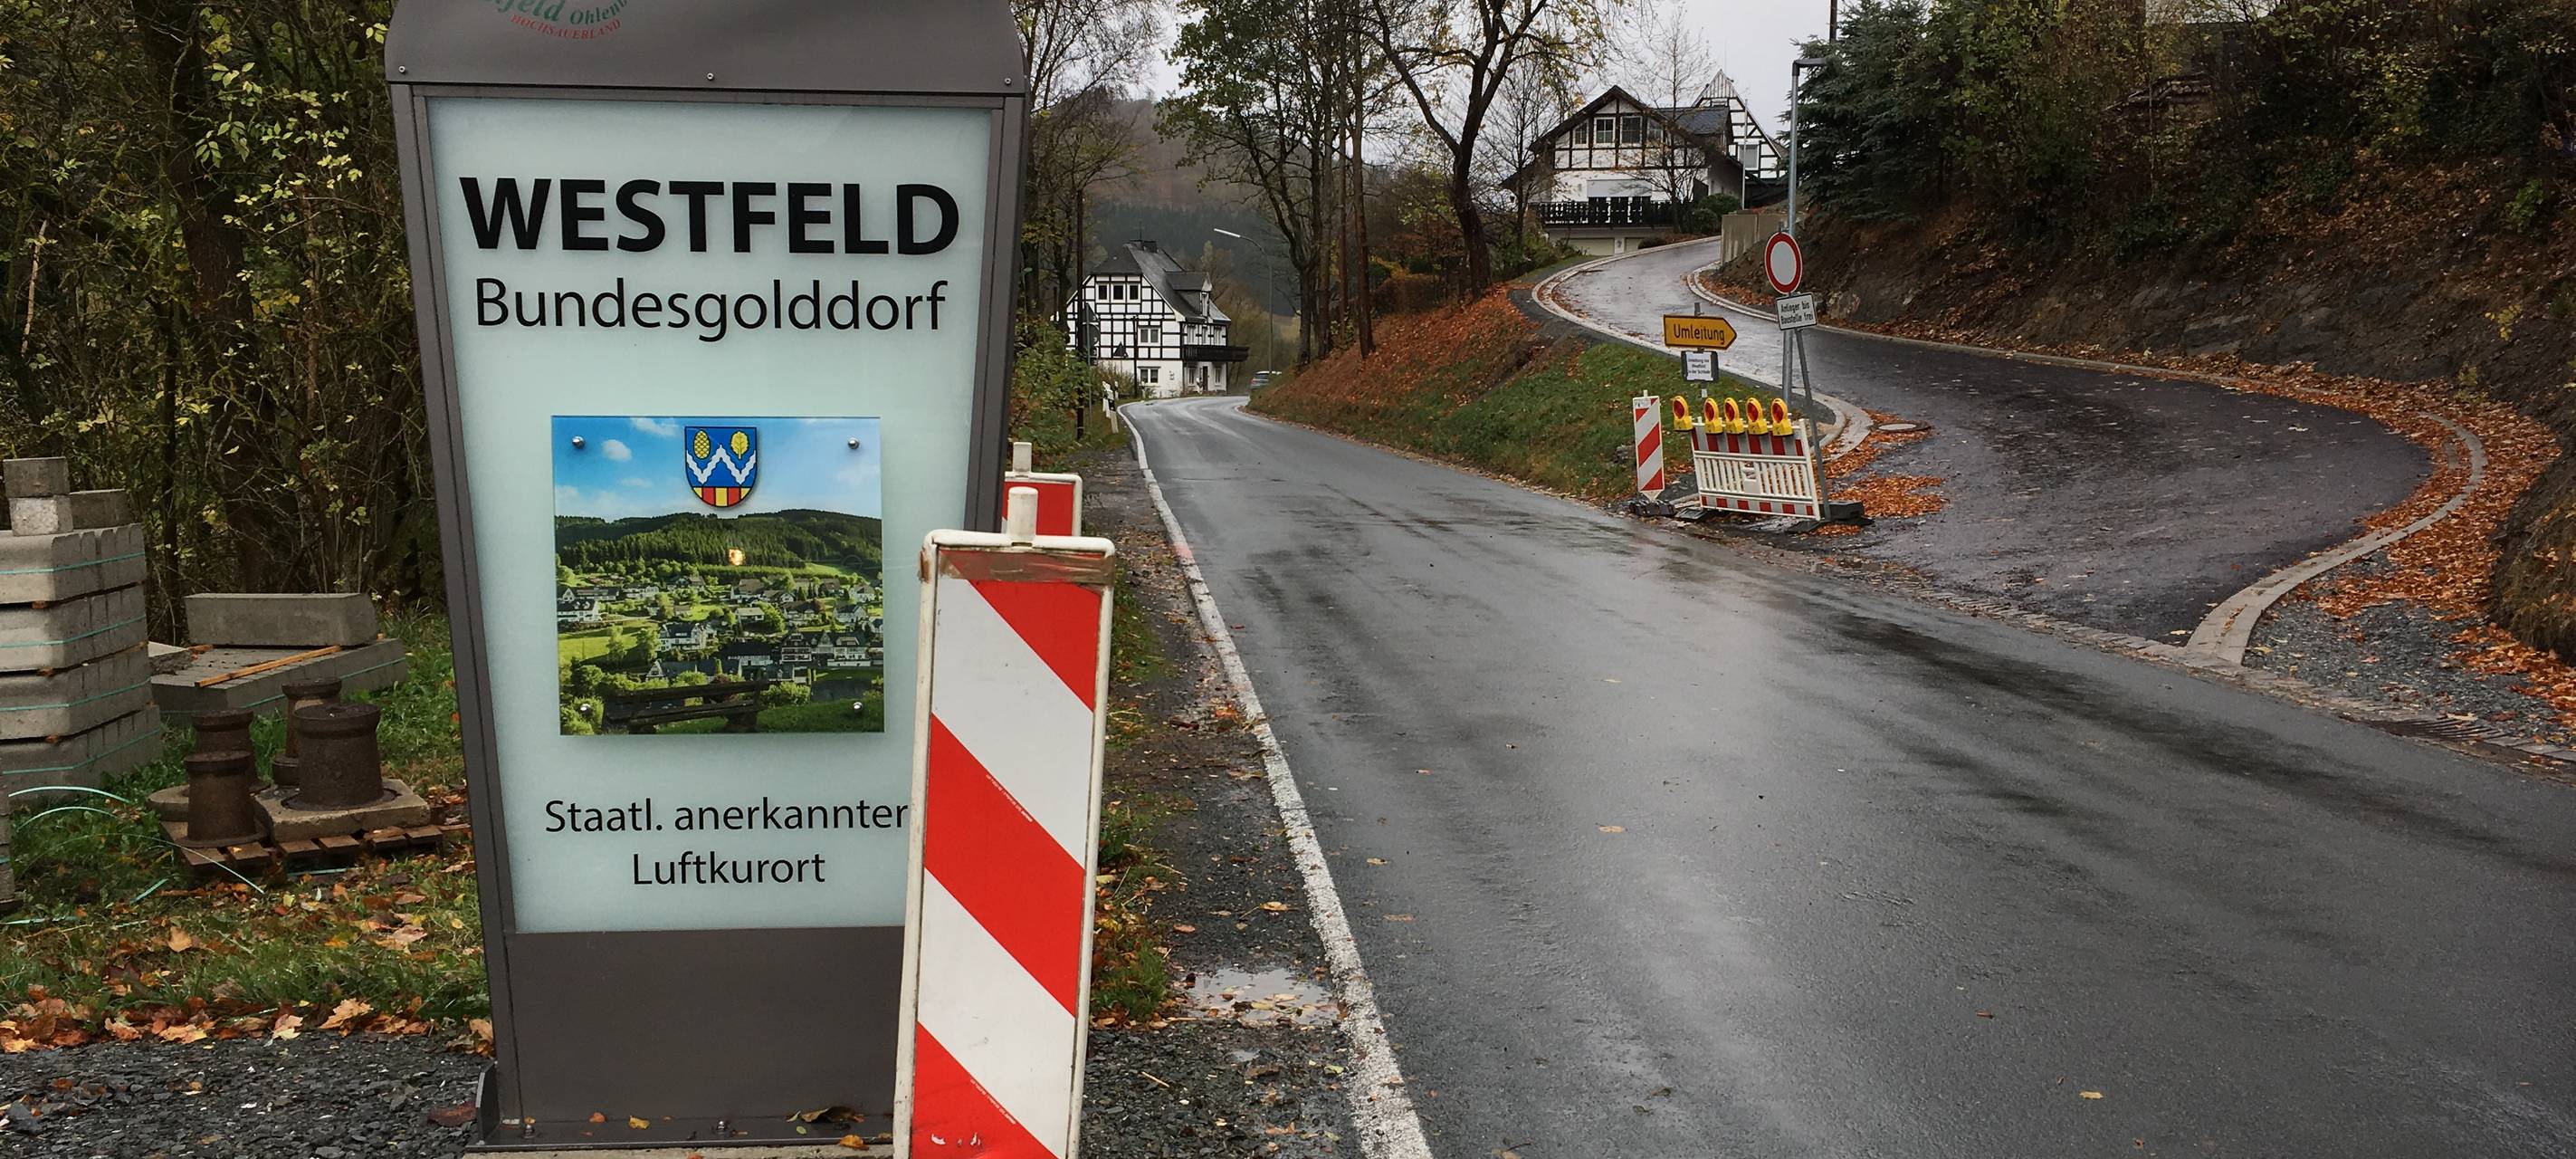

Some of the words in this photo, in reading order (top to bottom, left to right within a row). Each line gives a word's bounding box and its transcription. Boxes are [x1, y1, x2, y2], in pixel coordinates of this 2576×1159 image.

[510, 14, 622, 40] HOCHSAUERLAND
[459, 177, 959, 255] WESTFELD
[476, 277, 949, 341] Bundesgolddorf
[1801, 301, 1810, 310] bis
[1803, 311, 1814, 321] frei
[1673, 323, 1725, 345] Umleitung
[545, 798, 663, 833] Staatl.
[674, 797, 909, 831] anerkannter
[634, 851, 825, 886] Luftkurort
